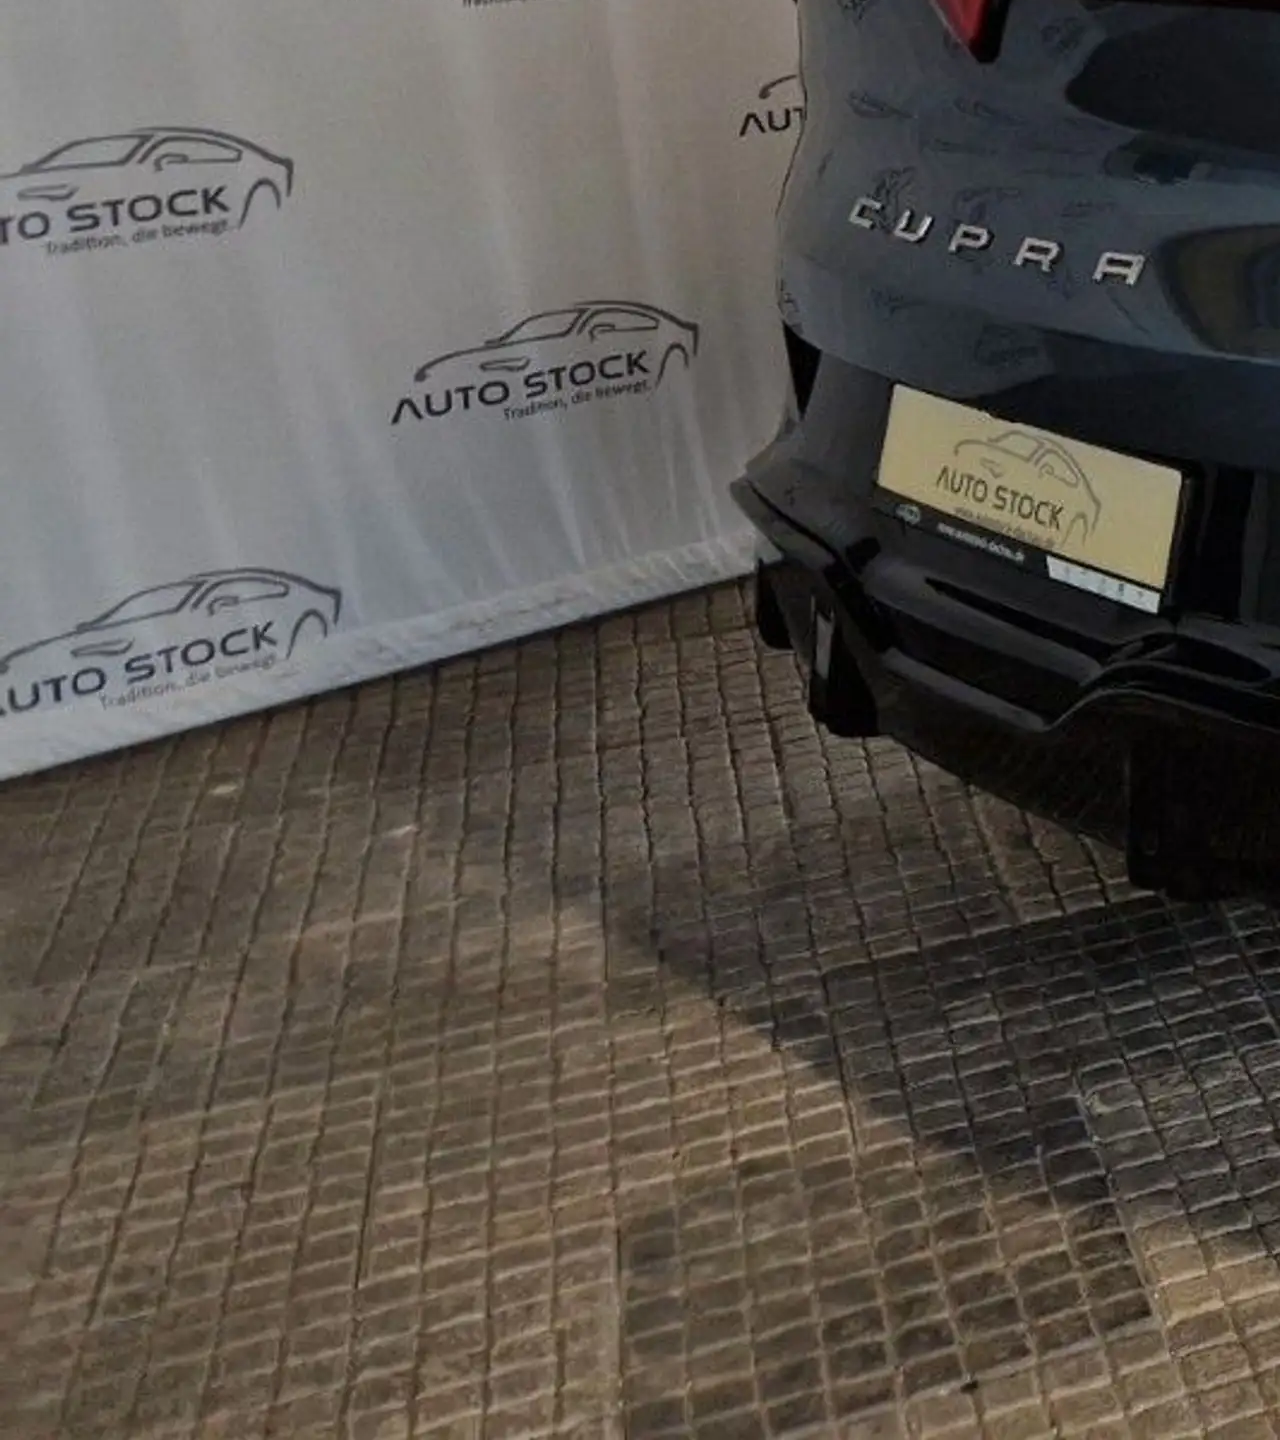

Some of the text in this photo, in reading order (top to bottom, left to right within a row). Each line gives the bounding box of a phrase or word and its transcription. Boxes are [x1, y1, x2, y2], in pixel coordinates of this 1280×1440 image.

[69, 186, 229, 232] STOCK
[132, 227, 157, 244] die
[848, 194, 1147, 286] CUPRA
[392, 349, 650, 424] AUTO STOCK
[935, 464, 988, 503] AUTO
[992, 485, 1064, 531] STOCK
[0, 620, 279, 717] UTO STOCK
